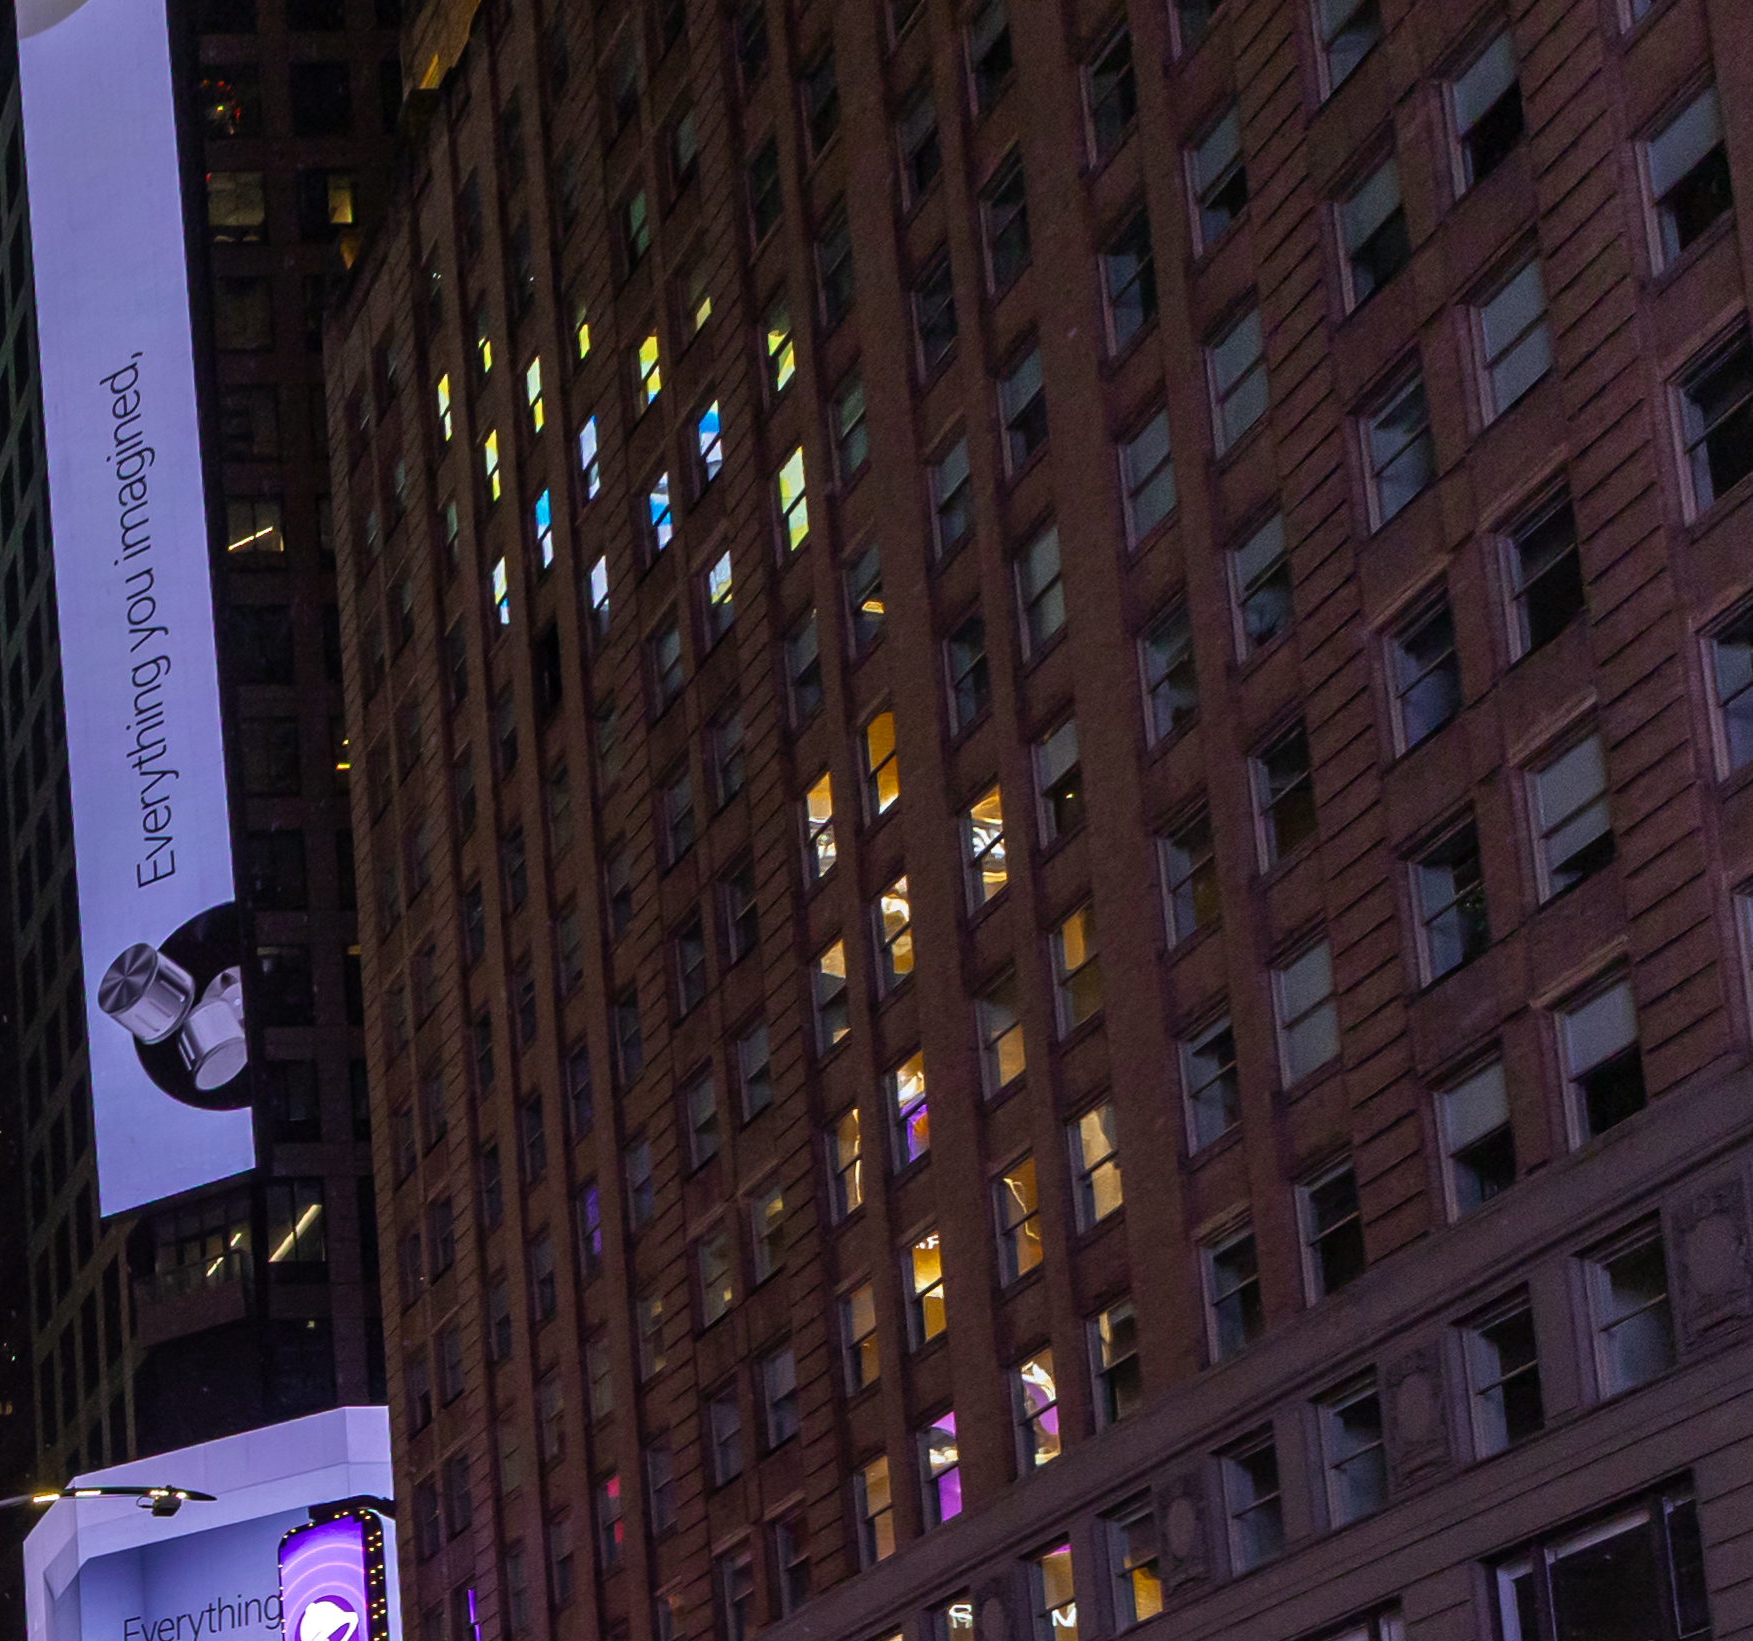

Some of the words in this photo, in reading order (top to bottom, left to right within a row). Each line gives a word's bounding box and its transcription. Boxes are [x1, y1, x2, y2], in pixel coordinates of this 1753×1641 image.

[100, 351, 156, 565] imagined,
[125, 567, 169, 652] you
[126, 655, 179, 888] Everything
